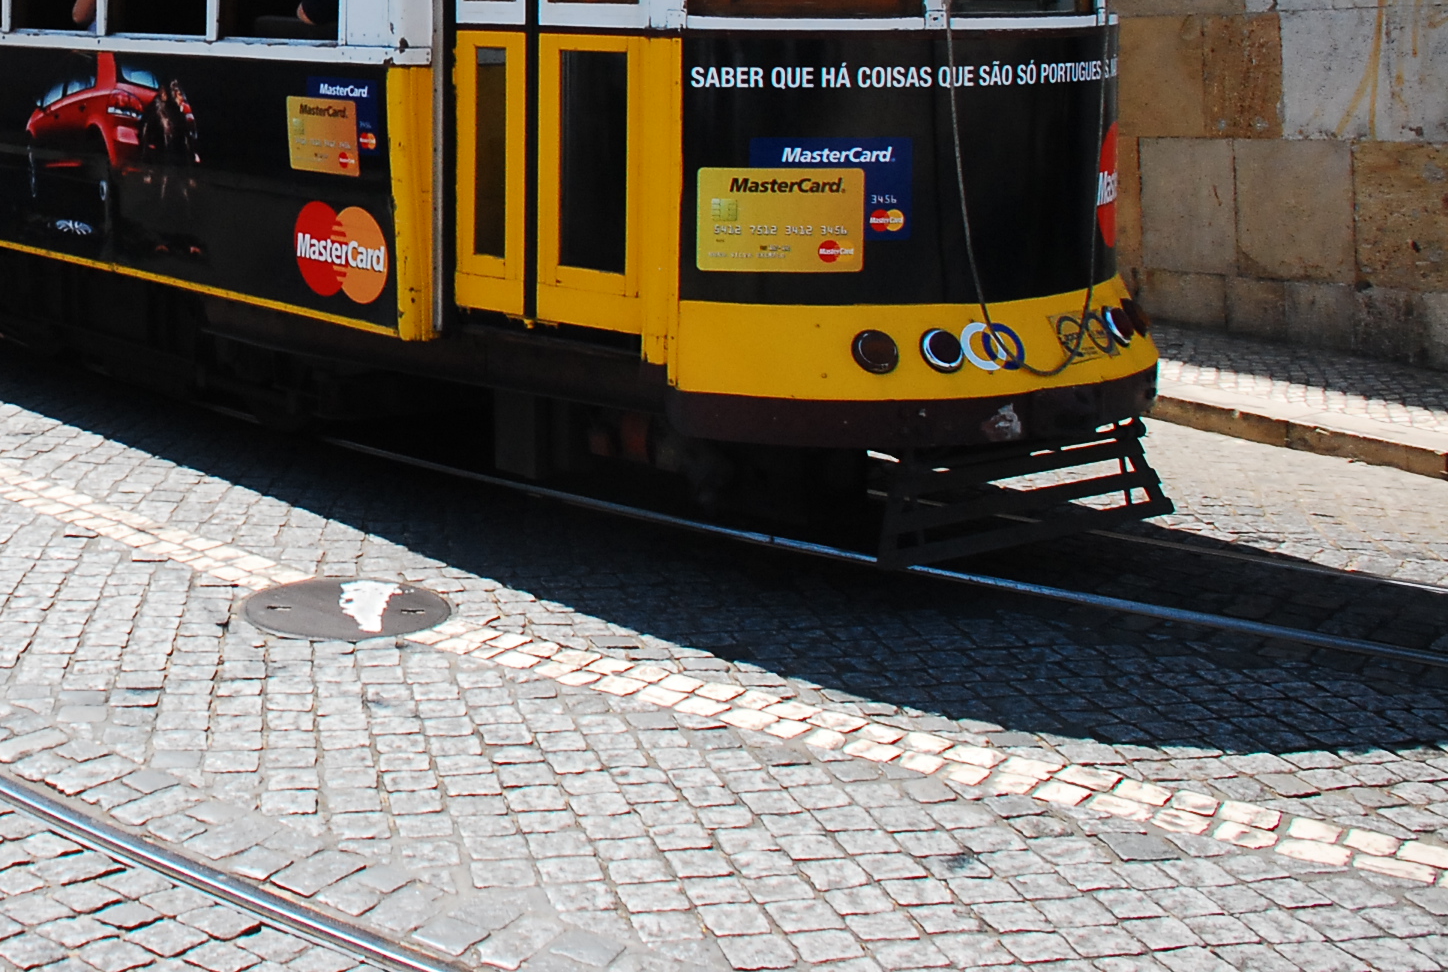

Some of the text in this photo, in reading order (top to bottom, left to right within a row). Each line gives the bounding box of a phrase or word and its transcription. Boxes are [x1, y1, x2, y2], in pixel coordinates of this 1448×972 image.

[690, 66, 764, 88] SABER
[771, 66, 814, 90] QUE
[821, 62, 851, 88] HÁ
[857, 66, 933, 88] COISAS
[938, 65, 975, 88] QUE
[979, 60, 1013, 87] SÃO
[1016, 59, 1036, 85] SÓ
[319, 83, 369, 98] MasterCard
[870, 194, 898, 204] 3456
[714, 224, 849, 236] 5412 7512 3412 3456
[297, 232, 386, 273] MasterCard
